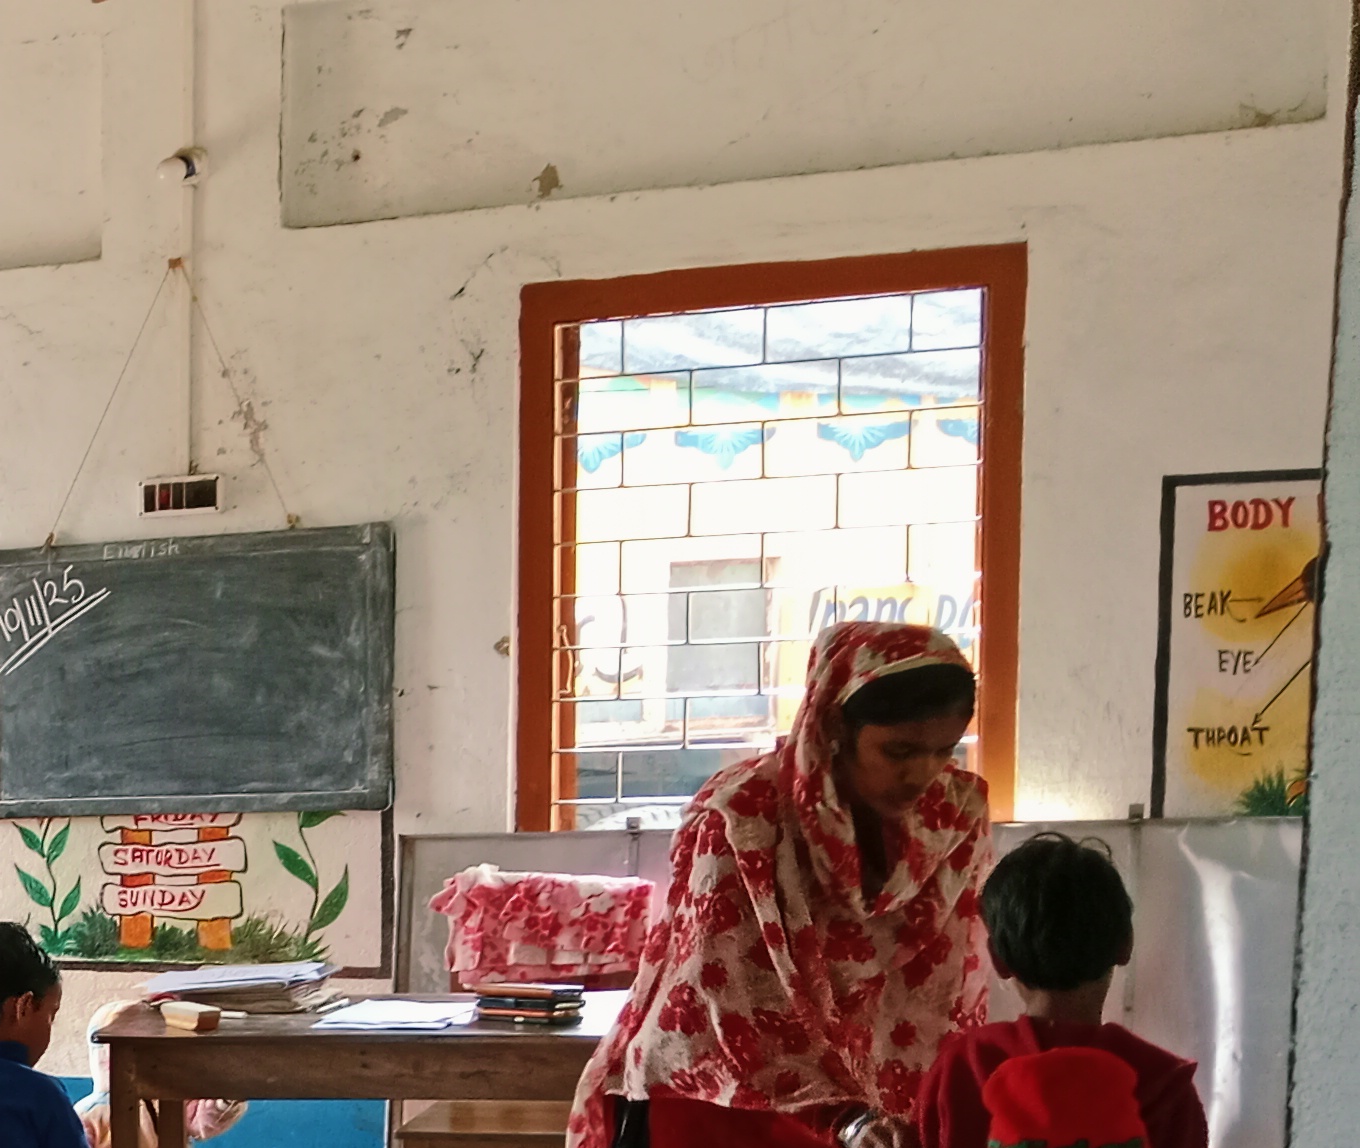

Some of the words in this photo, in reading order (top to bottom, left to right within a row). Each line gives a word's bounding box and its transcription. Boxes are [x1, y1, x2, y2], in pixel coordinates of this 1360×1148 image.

[1207, 496, 1296, 532] BODY
[1183, 590, 1233, 620] BEAK
[1217, 649, 1255, 676] EYE
[112, 846, 220, 869] SATURDAY
[118, 888, 206, 912] SUNDAY
